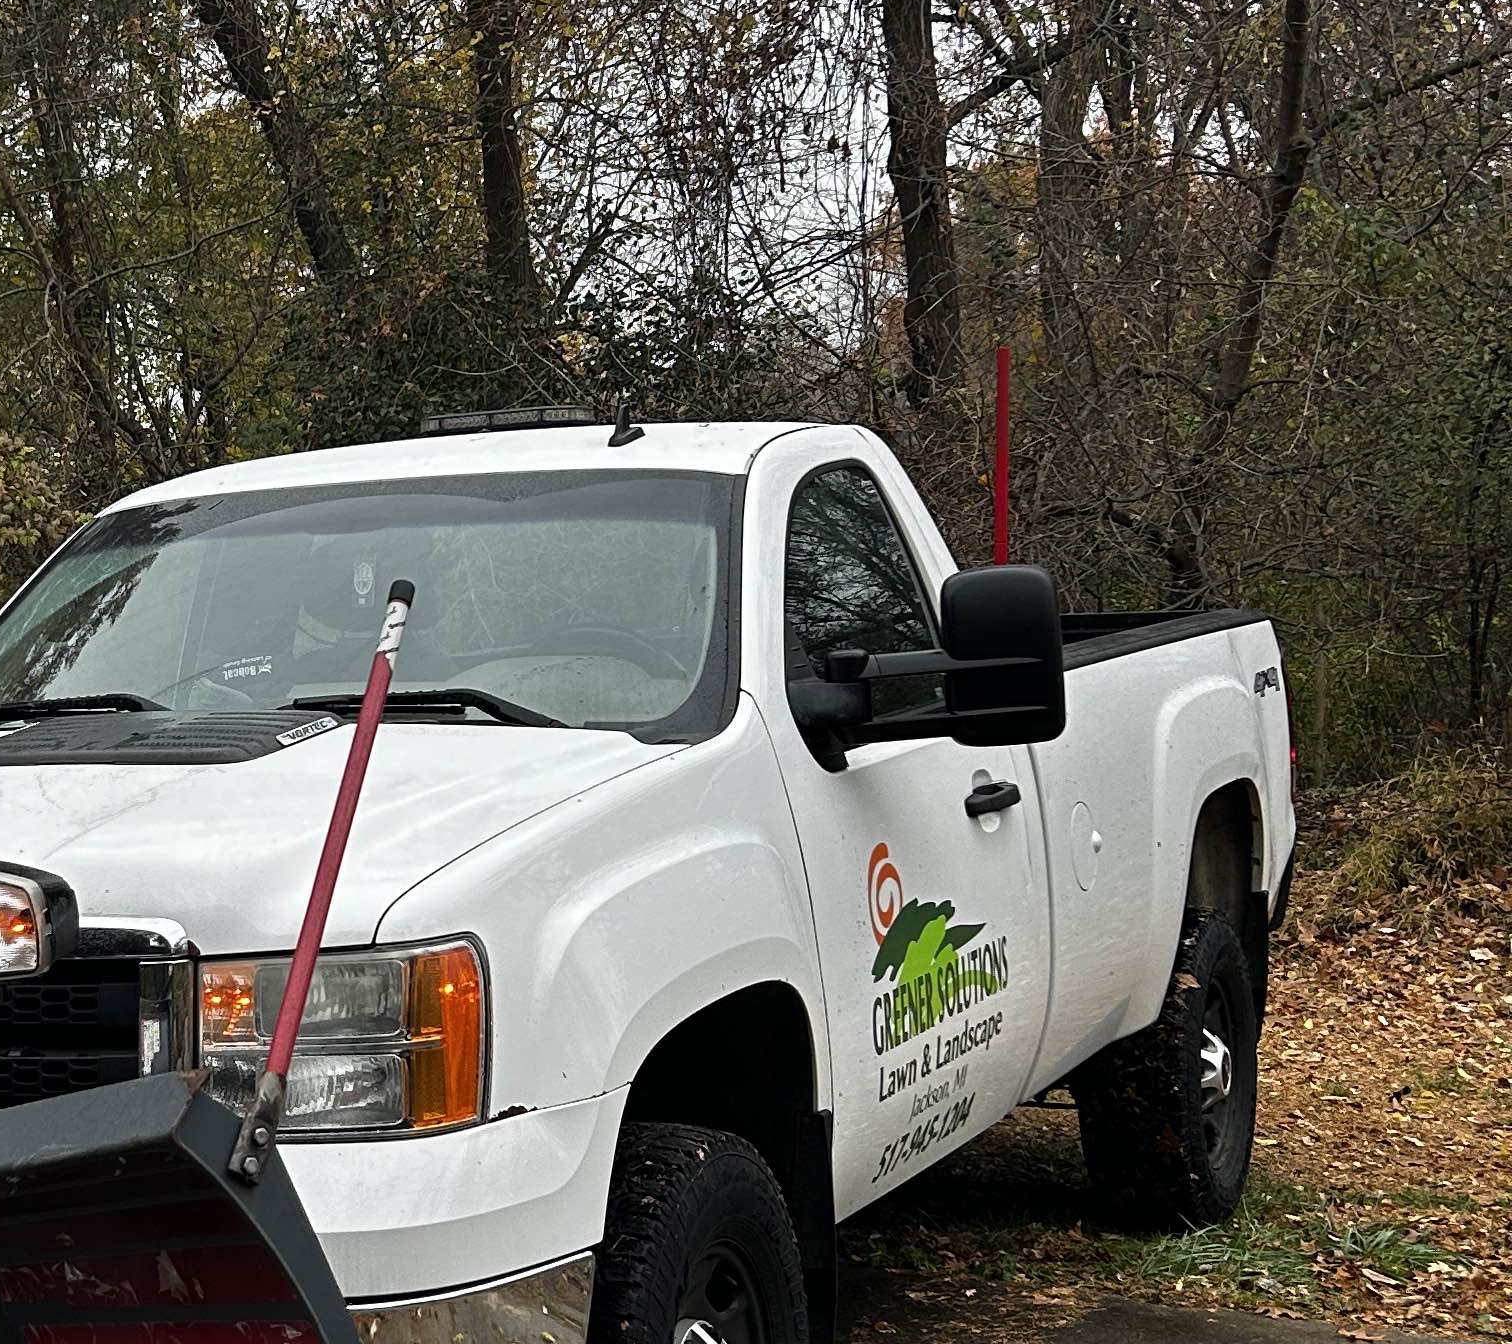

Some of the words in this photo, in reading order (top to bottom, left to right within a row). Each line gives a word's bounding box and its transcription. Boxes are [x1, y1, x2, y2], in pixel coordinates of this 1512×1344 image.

[873, 971, 936, 1056] GREENER
[937, 935, 1009, 1023] SOLUTIONS
[879, 1058, 917, 1103] Lawn
[921, 1044, 931, 1078] &
[936, 1011, 1003, 1070] Landscape
[952, 1064, 969, 1093] MI
